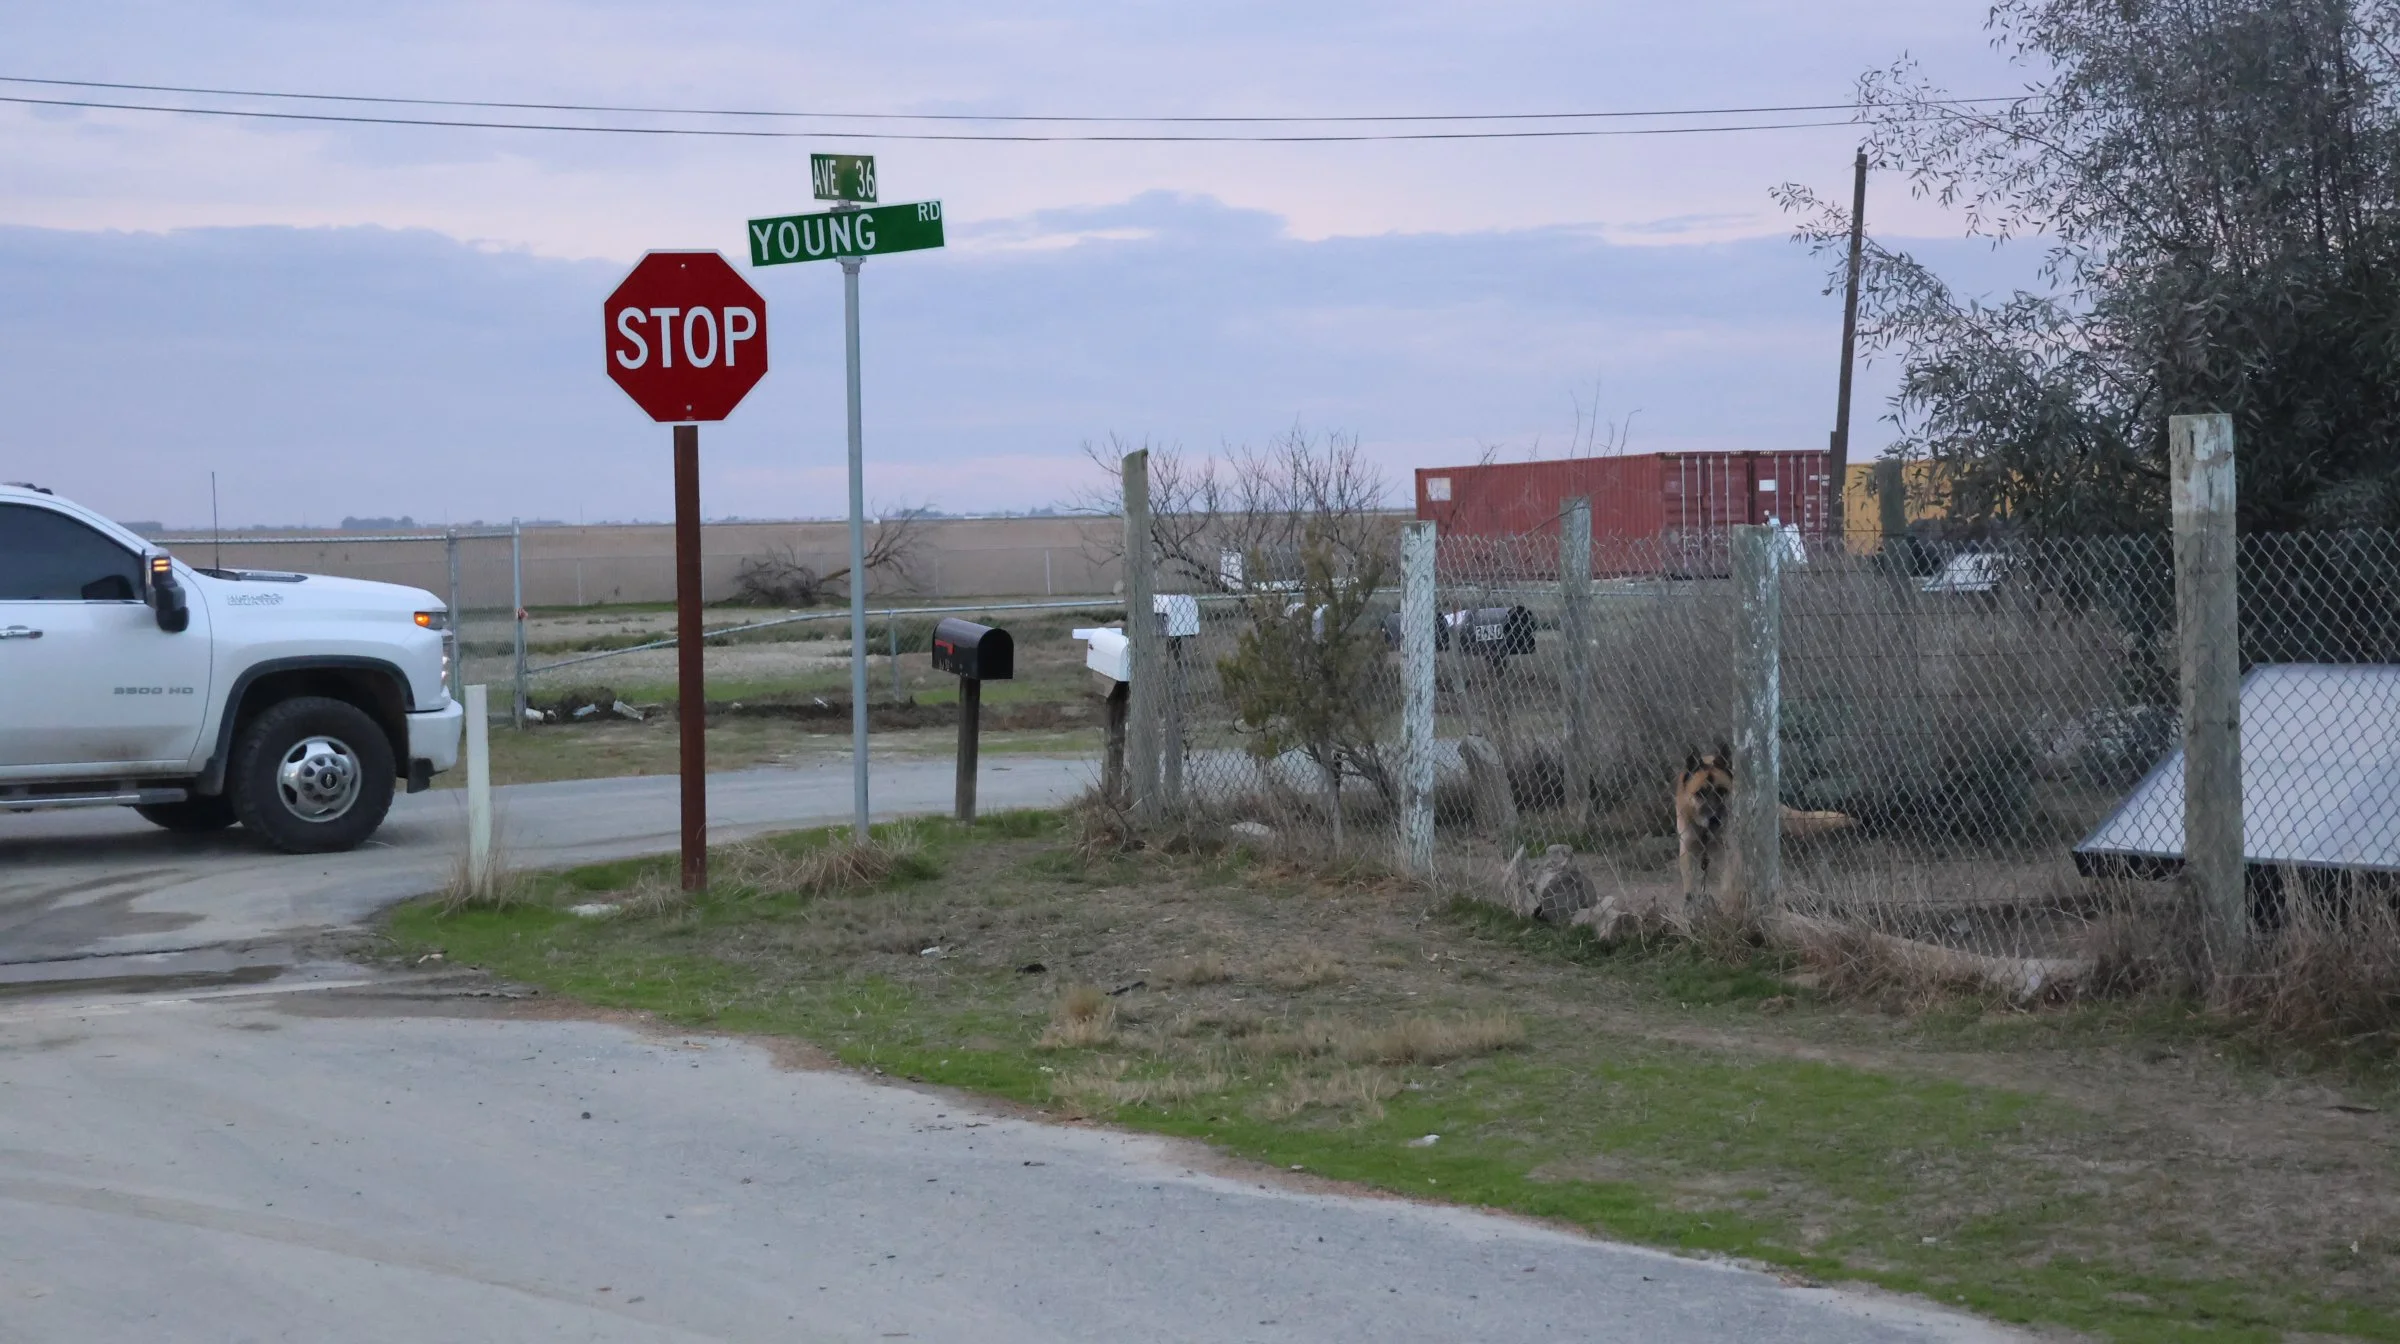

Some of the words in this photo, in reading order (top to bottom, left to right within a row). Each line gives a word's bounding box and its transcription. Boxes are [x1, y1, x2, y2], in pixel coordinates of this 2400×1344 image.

[813, 158, 840, 196] AVE
[855, 159, 876, 199] 36
[751, 213, 877, 261] YOUNG
[917, 201, 941, 222] RD
[615, 305, 758, 370] STOP
[168, 686, 194, 695] HD
